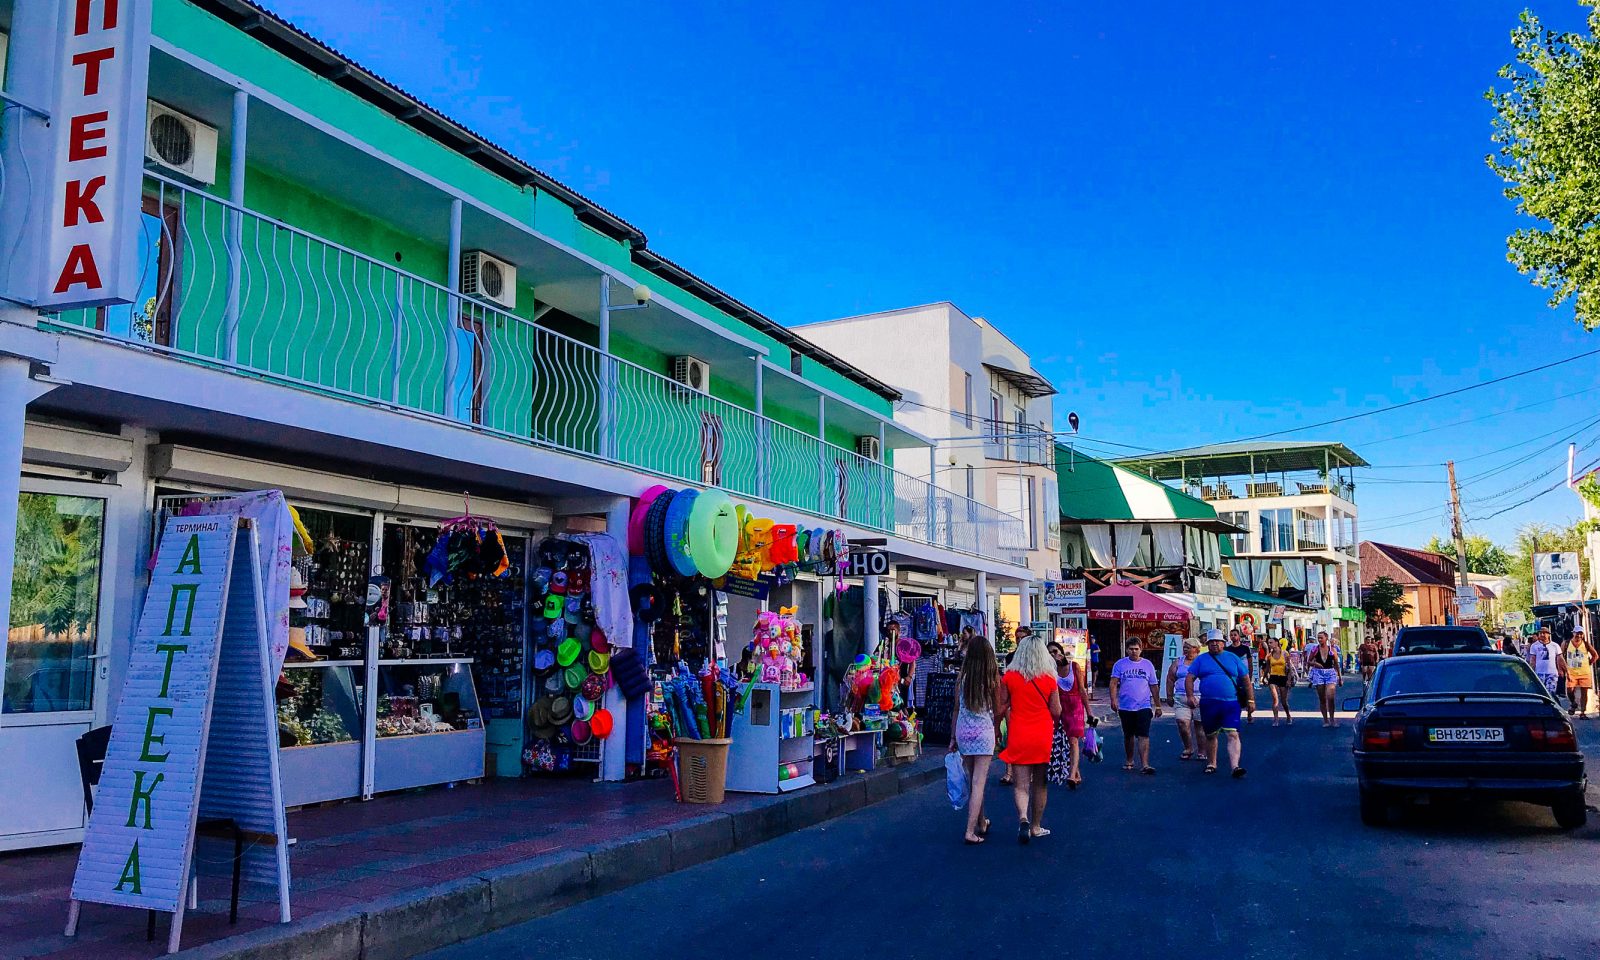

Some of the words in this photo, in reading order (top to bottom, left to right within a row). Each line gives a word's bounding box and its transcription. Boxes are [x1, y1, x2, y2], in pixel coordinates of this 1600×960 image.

[175, 522, 219, 533] ТЕРМИНАЛ
[1536, 573, 1579, 582] СТОЛОВАЯ
[114, 533, 203, 895] АПТЕКА
[1436, 729, 1453, 740] BH
[1455, 729, 1481, 740] 8215
[1484, 729, 1501, 740] AP
